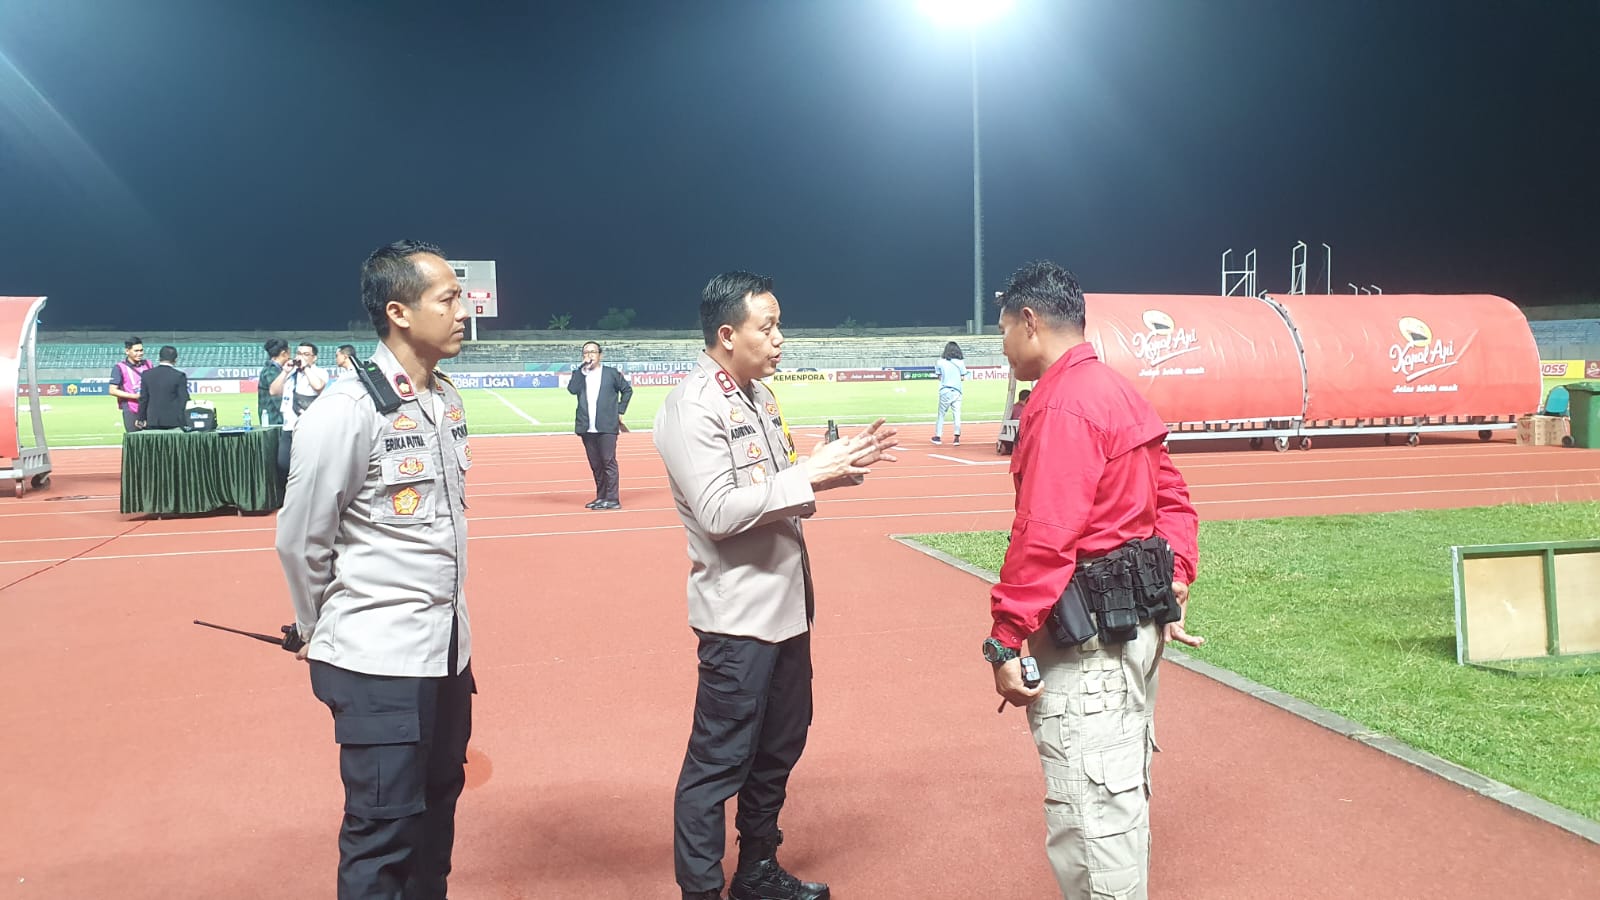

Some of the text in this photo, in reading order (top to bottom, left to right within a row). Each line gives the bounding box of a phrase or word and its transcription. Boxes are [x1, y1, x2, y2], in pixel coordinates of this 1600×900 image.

[1389, 339, 1455, 375] Kapal Api
[984, 370, 1009, 379] Miner
[1541, 364, 1566, 375] OSS
[634, 375, 682, 385] KukuBim
[186, 381, 222, 393] RImo
[385, 435, 425, 452] ERIKA PUTRA
